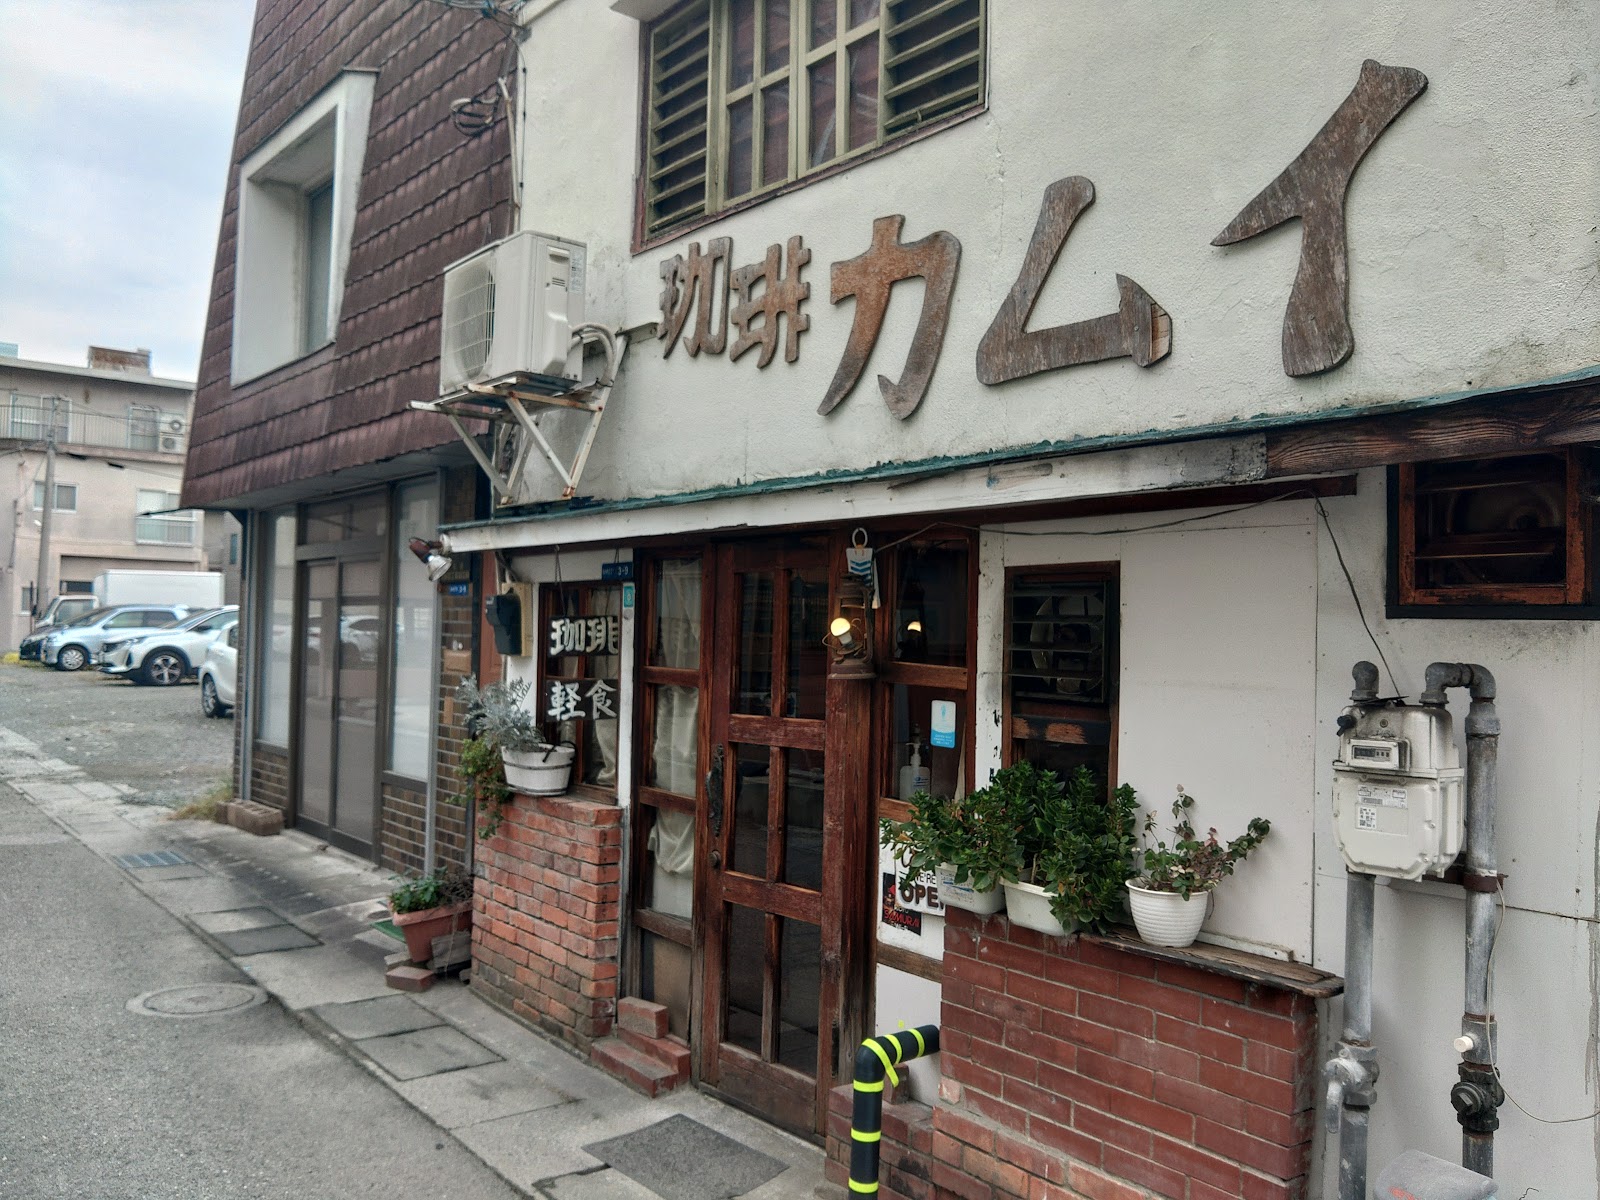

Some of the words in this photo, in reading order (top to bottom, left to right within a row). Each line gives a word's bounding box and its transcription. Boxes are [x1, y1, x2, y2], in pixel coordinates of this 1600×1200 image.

[657, 59, 1429, 421] 珈琲カムイ
[550, 616, 619, 655] 珈琲
[548, 679, 618, 721] 軽食
[901, 884, 945, 910] OPE
[915, 872, 936, 885] E'RE
